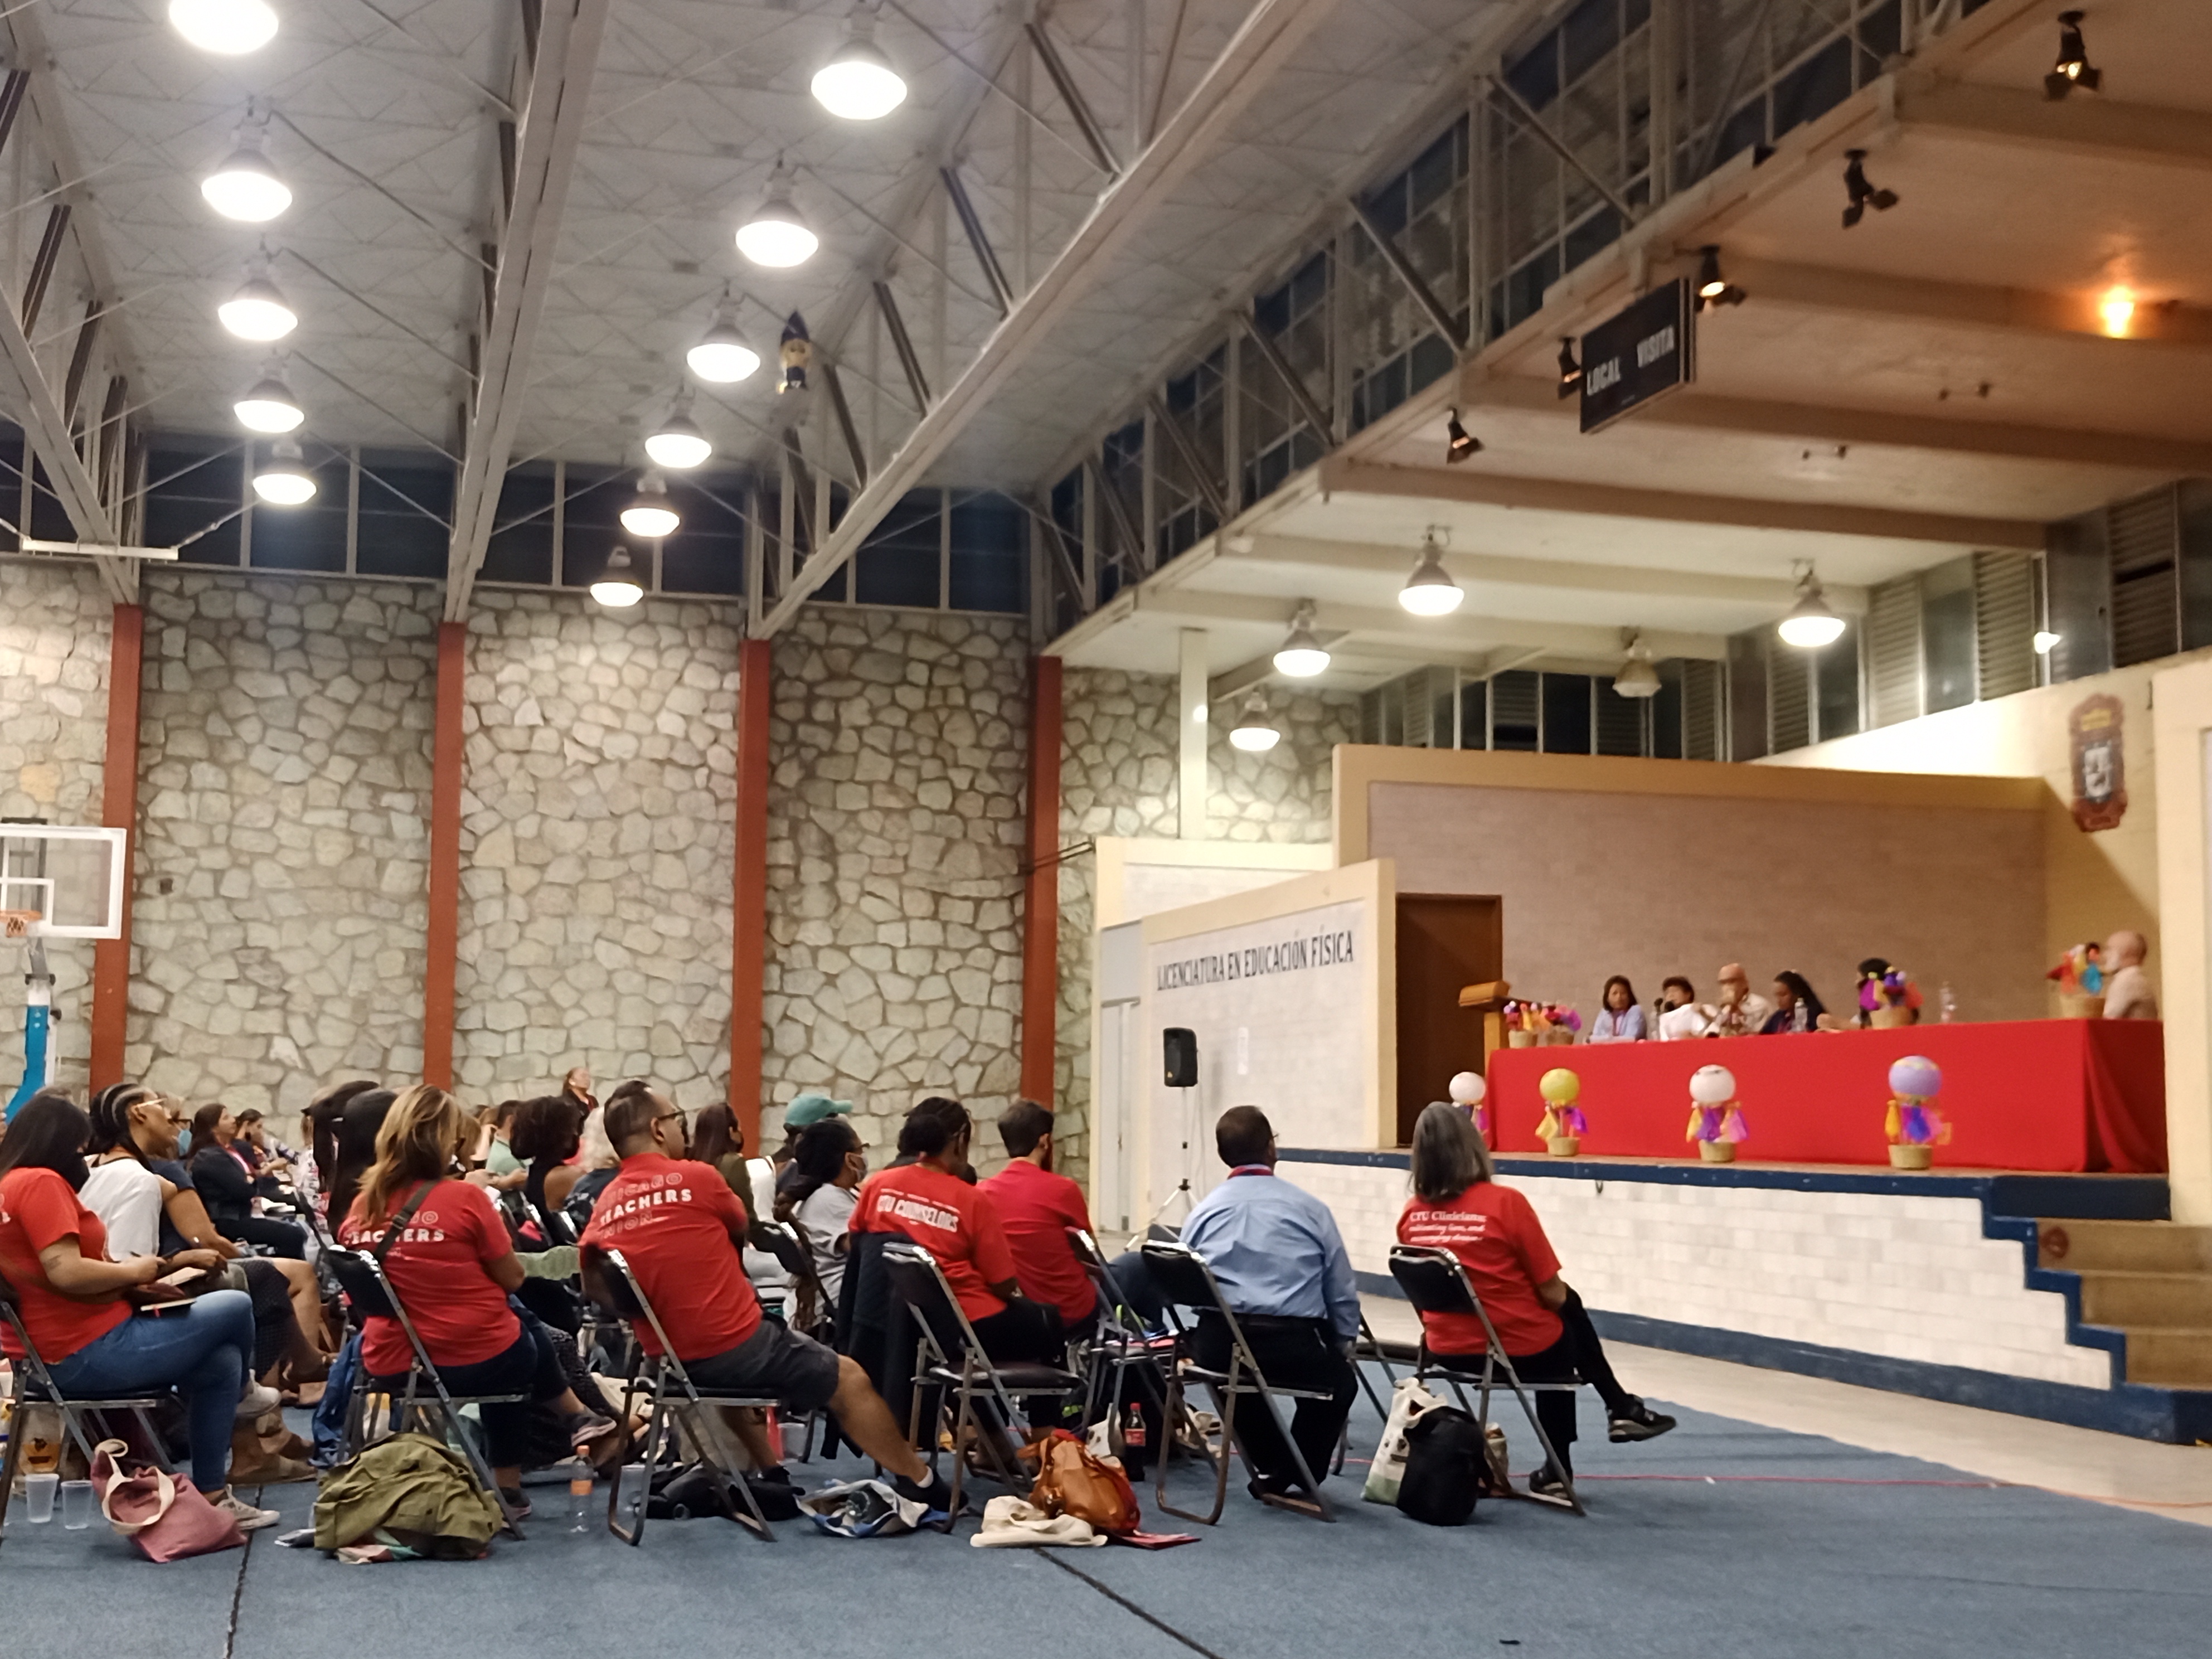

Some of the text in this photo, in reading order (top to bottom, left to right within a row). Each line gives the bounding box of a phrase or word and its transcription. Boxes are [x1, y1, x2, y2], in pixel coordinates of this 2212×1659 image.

[1587, 356, 1621, 396] LOCAL
[1157, 924, 1354, 991] LICENCIATURA EN EDUCACIÓN FÍSICA
